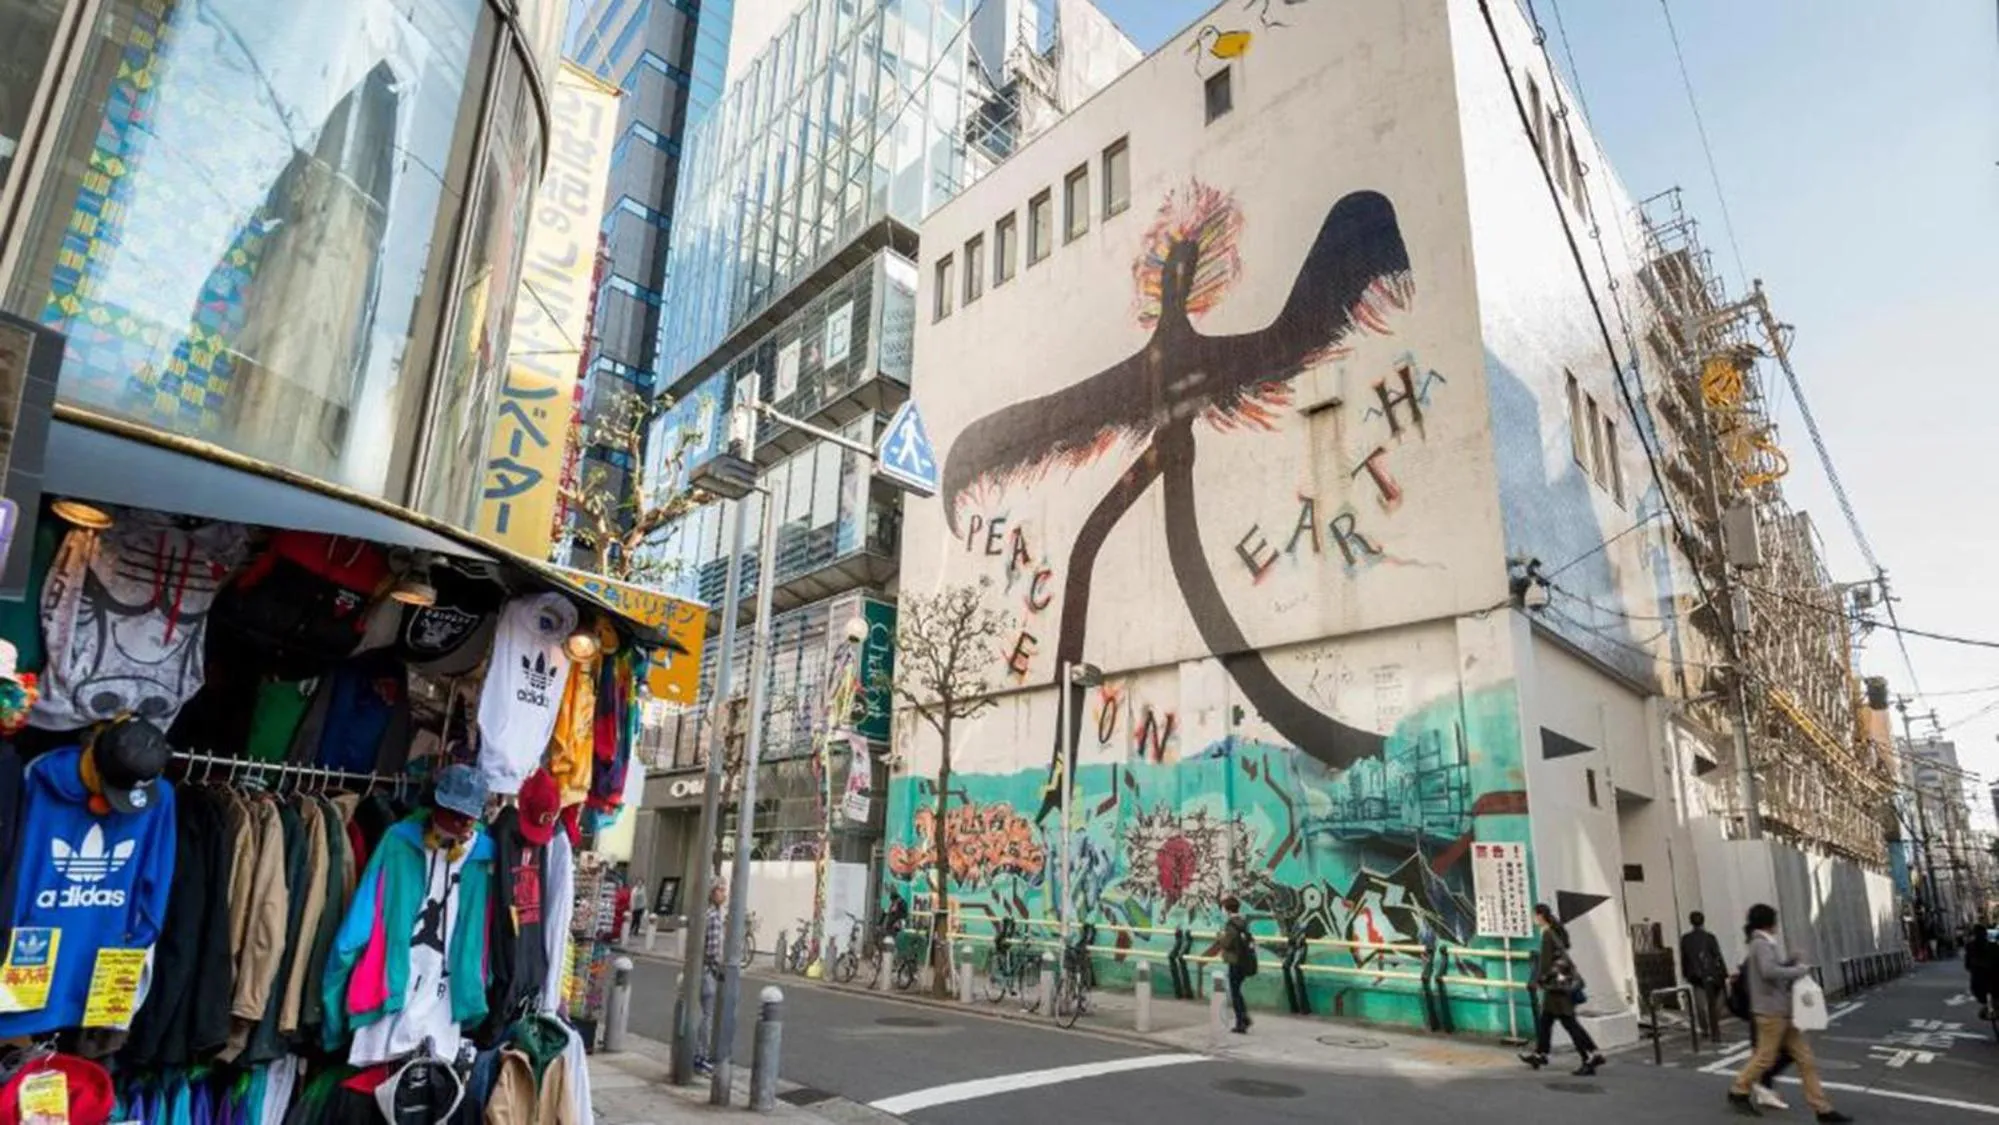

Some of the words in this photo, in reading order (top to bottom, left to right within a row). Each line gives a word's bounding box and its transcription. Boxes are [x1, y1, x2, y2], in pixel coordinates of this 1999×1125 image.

[1236, 366, 1427, 578] EARTH
[965, 512, 1054, 676] PEACE
[516, 688, 549, 709] adid
[1098, 688, 1176, 763] ON
[36, 885, 126, 909] adidas
